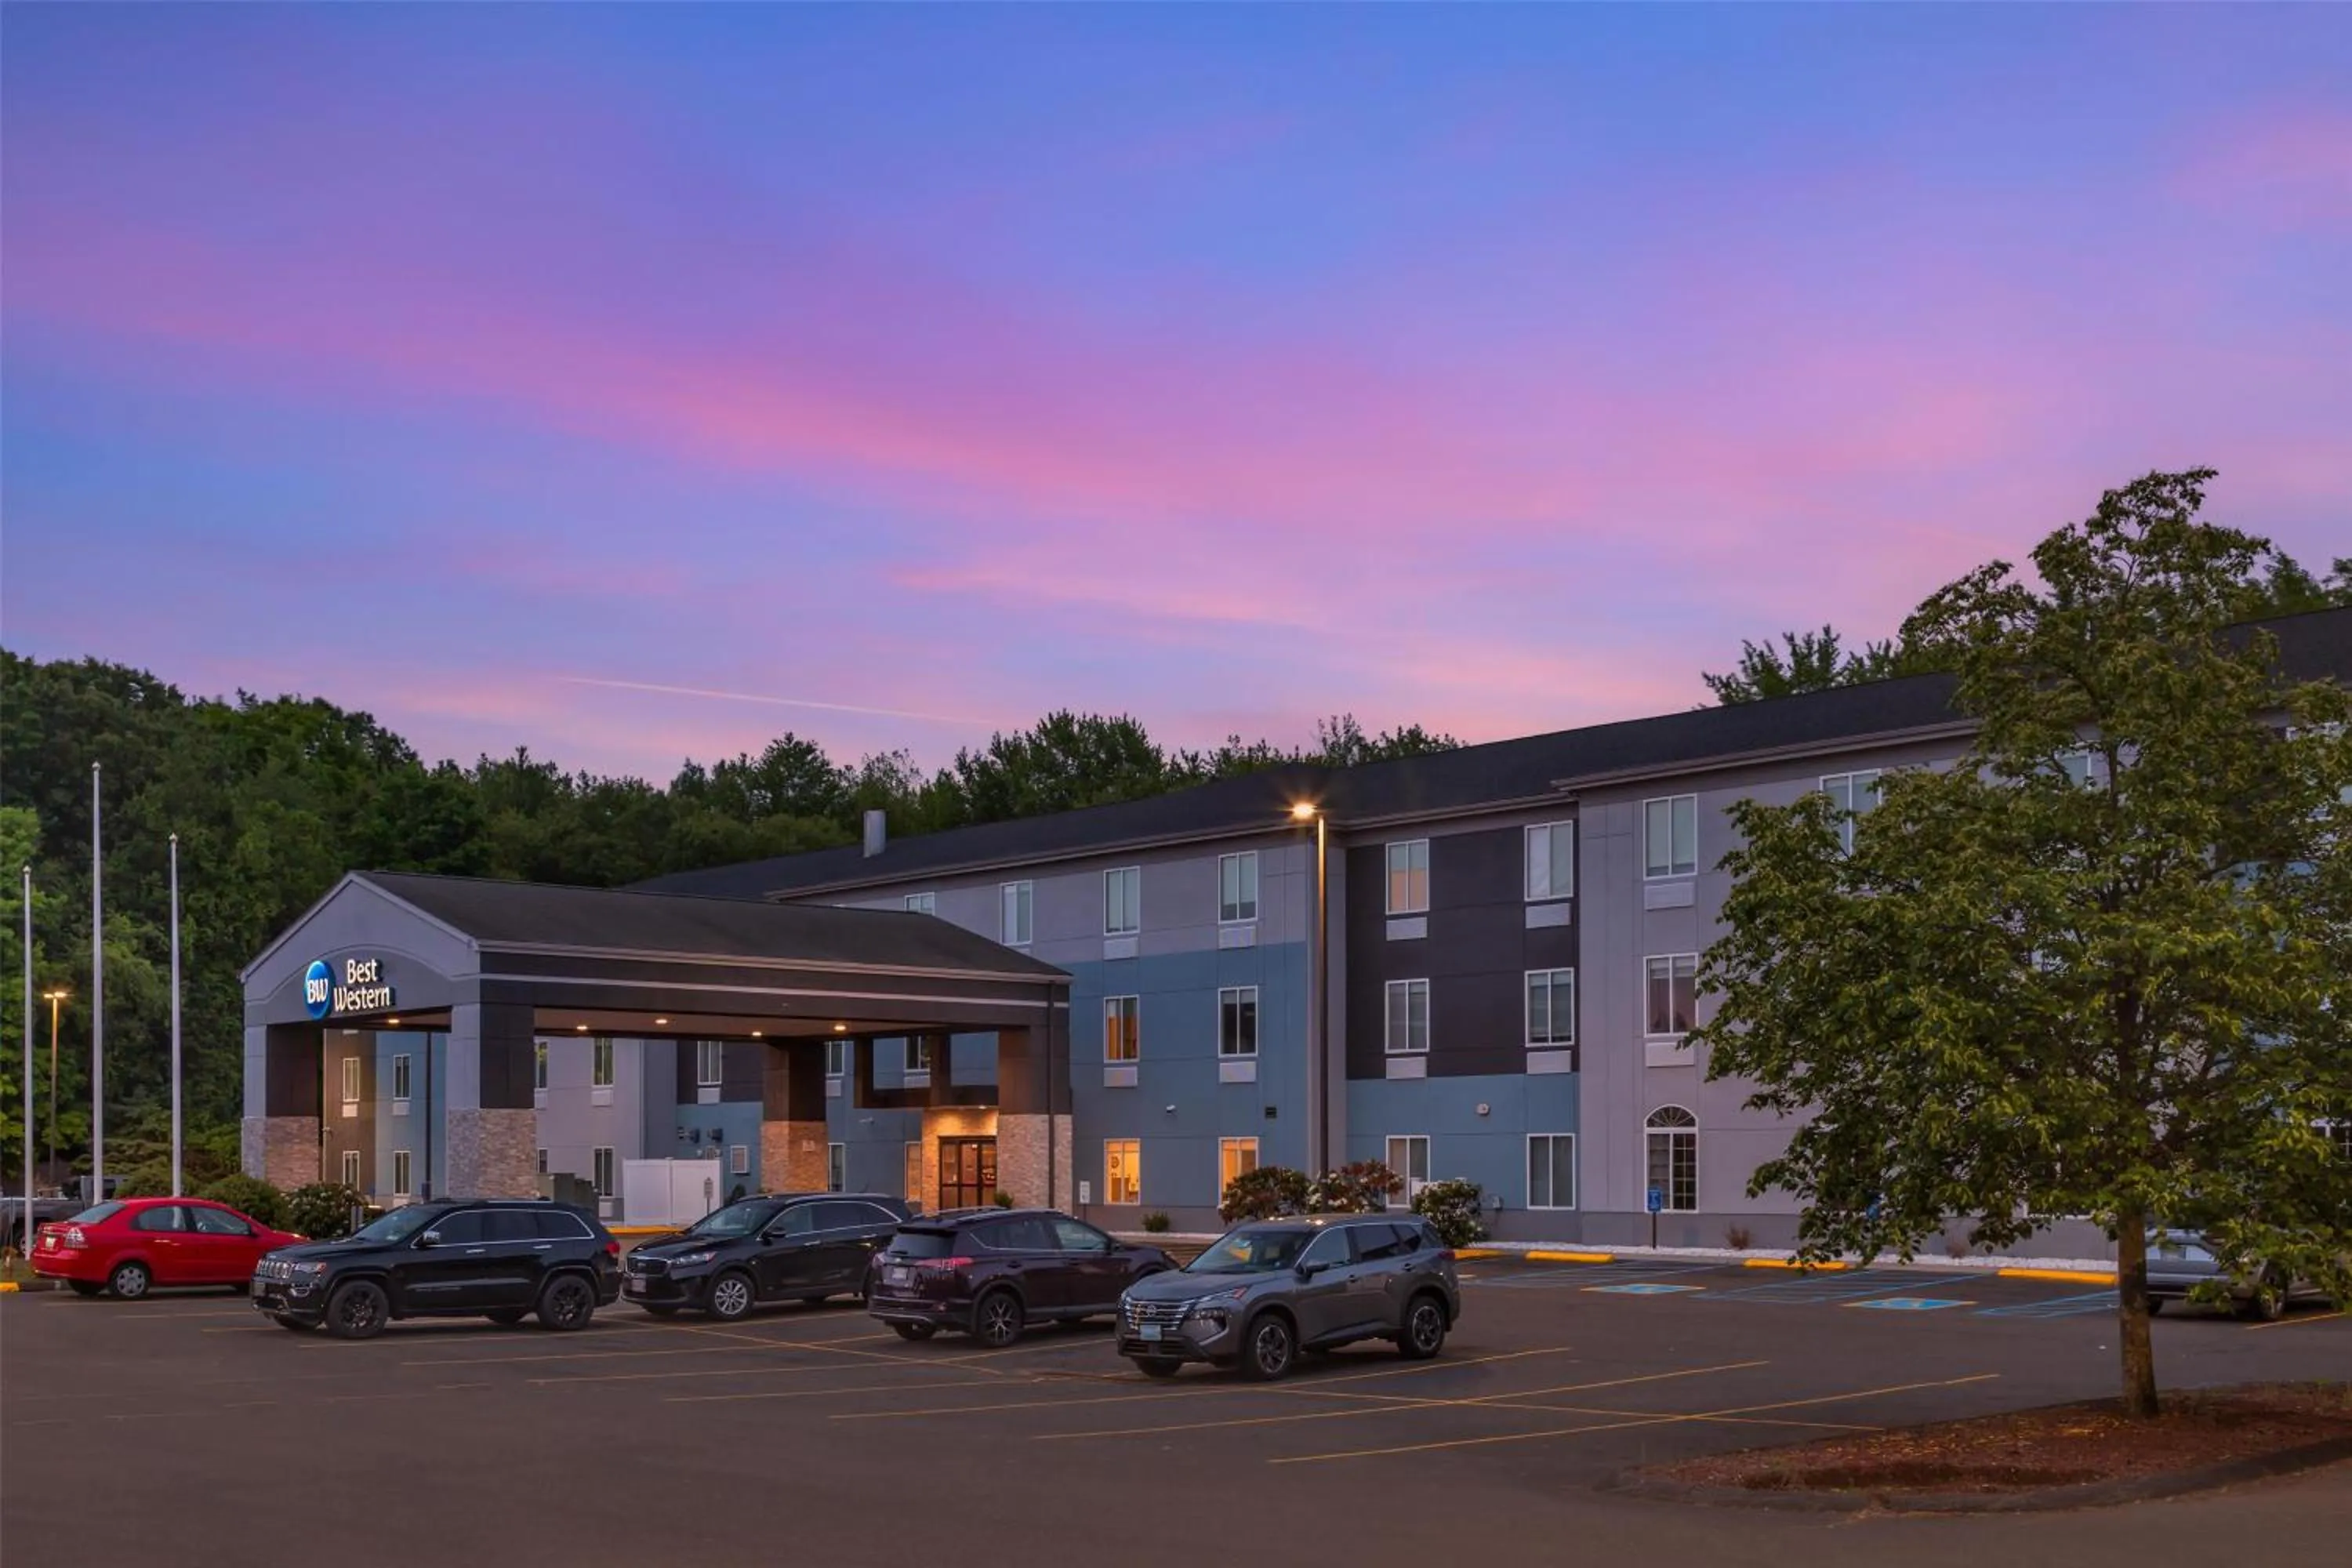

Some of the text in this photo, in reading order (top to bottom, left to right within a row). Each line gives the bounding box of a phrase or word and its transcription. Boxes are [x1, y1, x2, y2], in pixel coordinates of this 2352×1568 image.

[347, 958, 378, 984] Best
[307, 978, 328, 1004] BW
[333, 986, 390, 1012] Western
